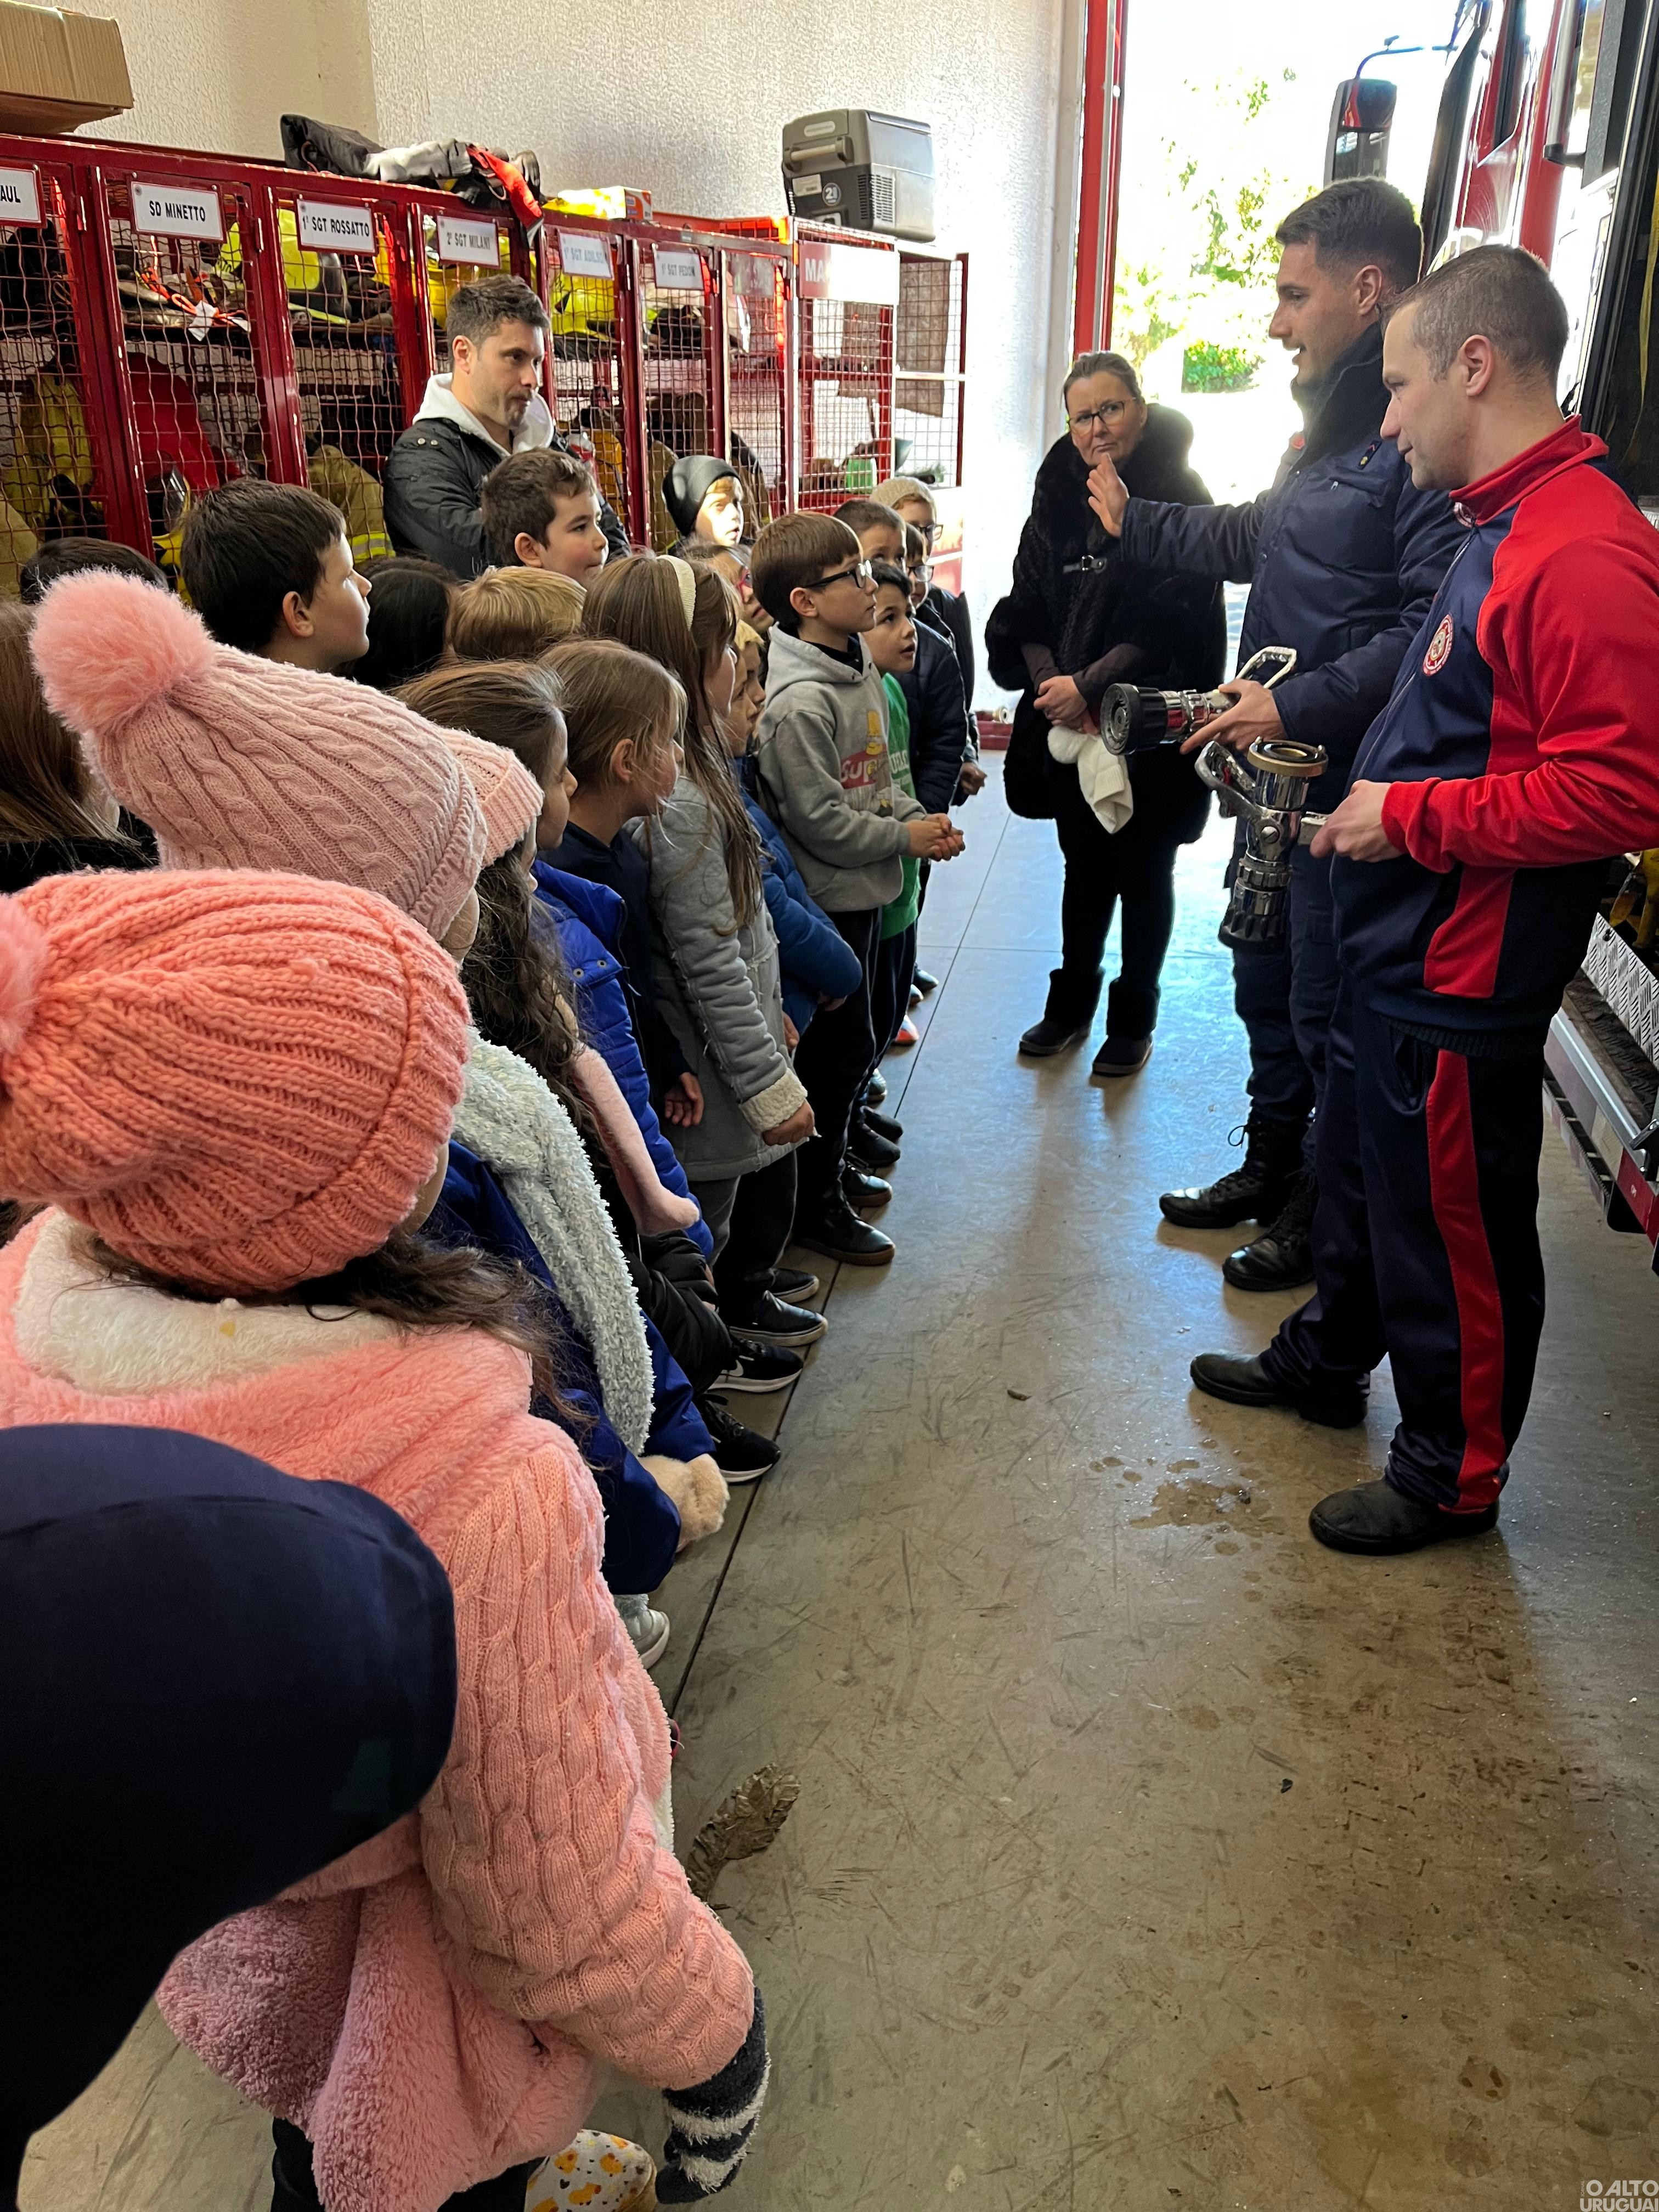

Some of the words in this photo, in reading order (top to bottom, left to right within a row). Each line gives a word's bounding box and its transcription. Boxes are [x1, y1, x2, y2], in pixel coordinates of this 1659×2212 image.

[149, 200, 161, 216] SD
[165, 202, 206, 222] MINETTO
[312, 216, 327, 232] SGT
[330, 218, 370, 237] ROSSATTO
[454, 232, 466, 247] SGT
